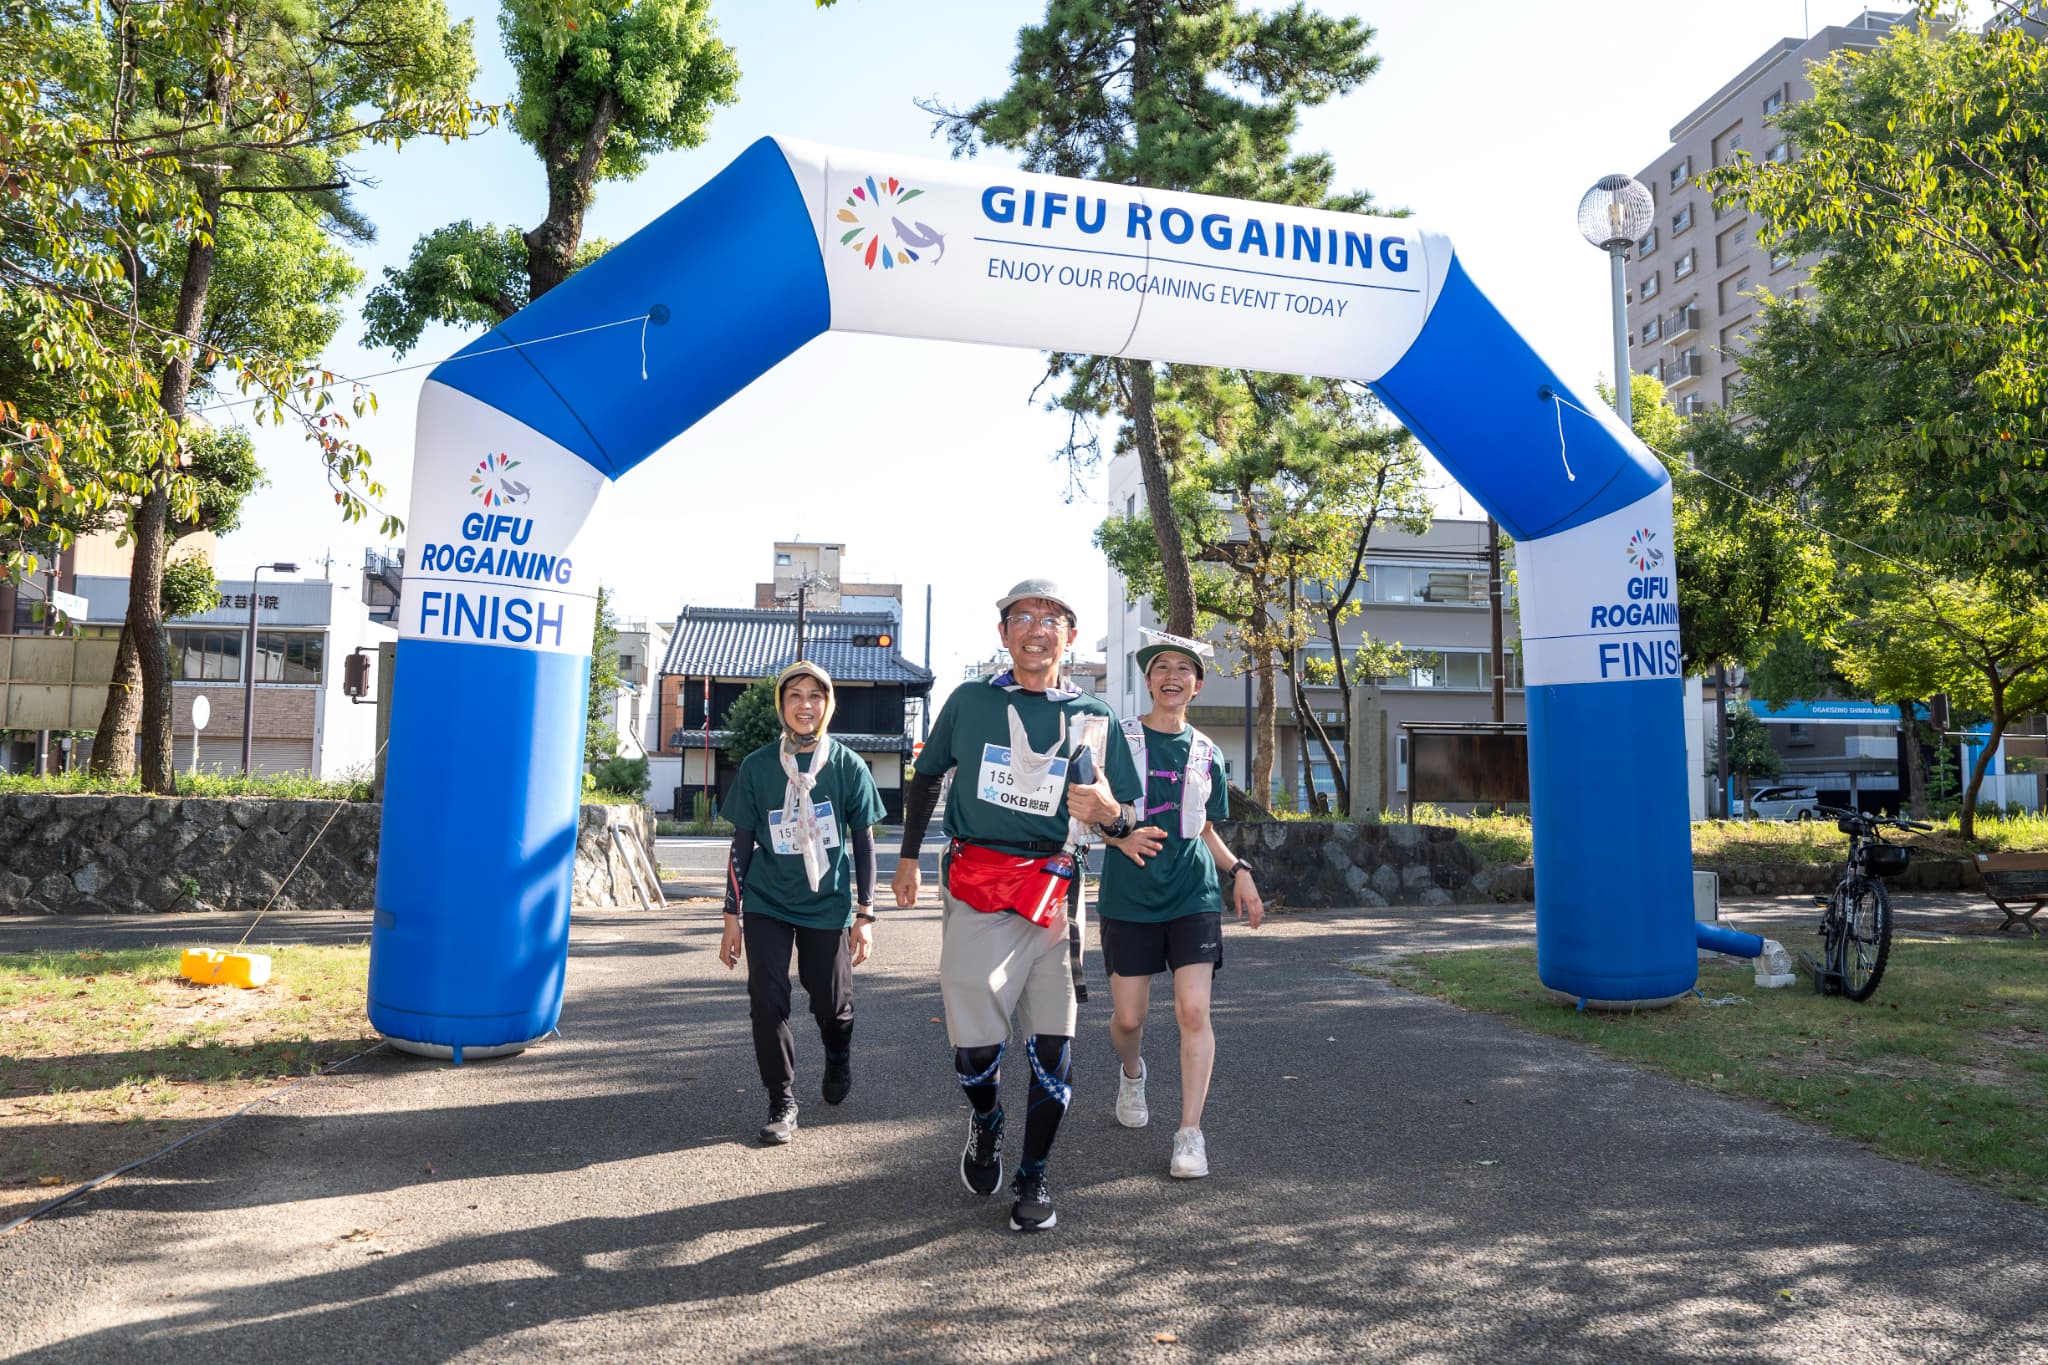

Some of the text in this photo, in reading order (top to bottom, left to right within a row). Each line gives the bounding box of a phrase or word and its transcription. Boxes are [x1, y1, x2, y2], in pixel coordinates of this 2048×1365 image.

[981, 185, 1409, 273] GIFU ROGAINING
[987, 257, 1349, 318] ENJOY OUR ROGAINING EVENT TODAY
[462, 512, 534, 546] GIFU
[420, 543, 573, 585] ROGAINING
[1627, 576, 1669, 600] GIFU
[419, 590, 565, 647] FINISH
[1001, 793, 1050, 811] OKB総研
